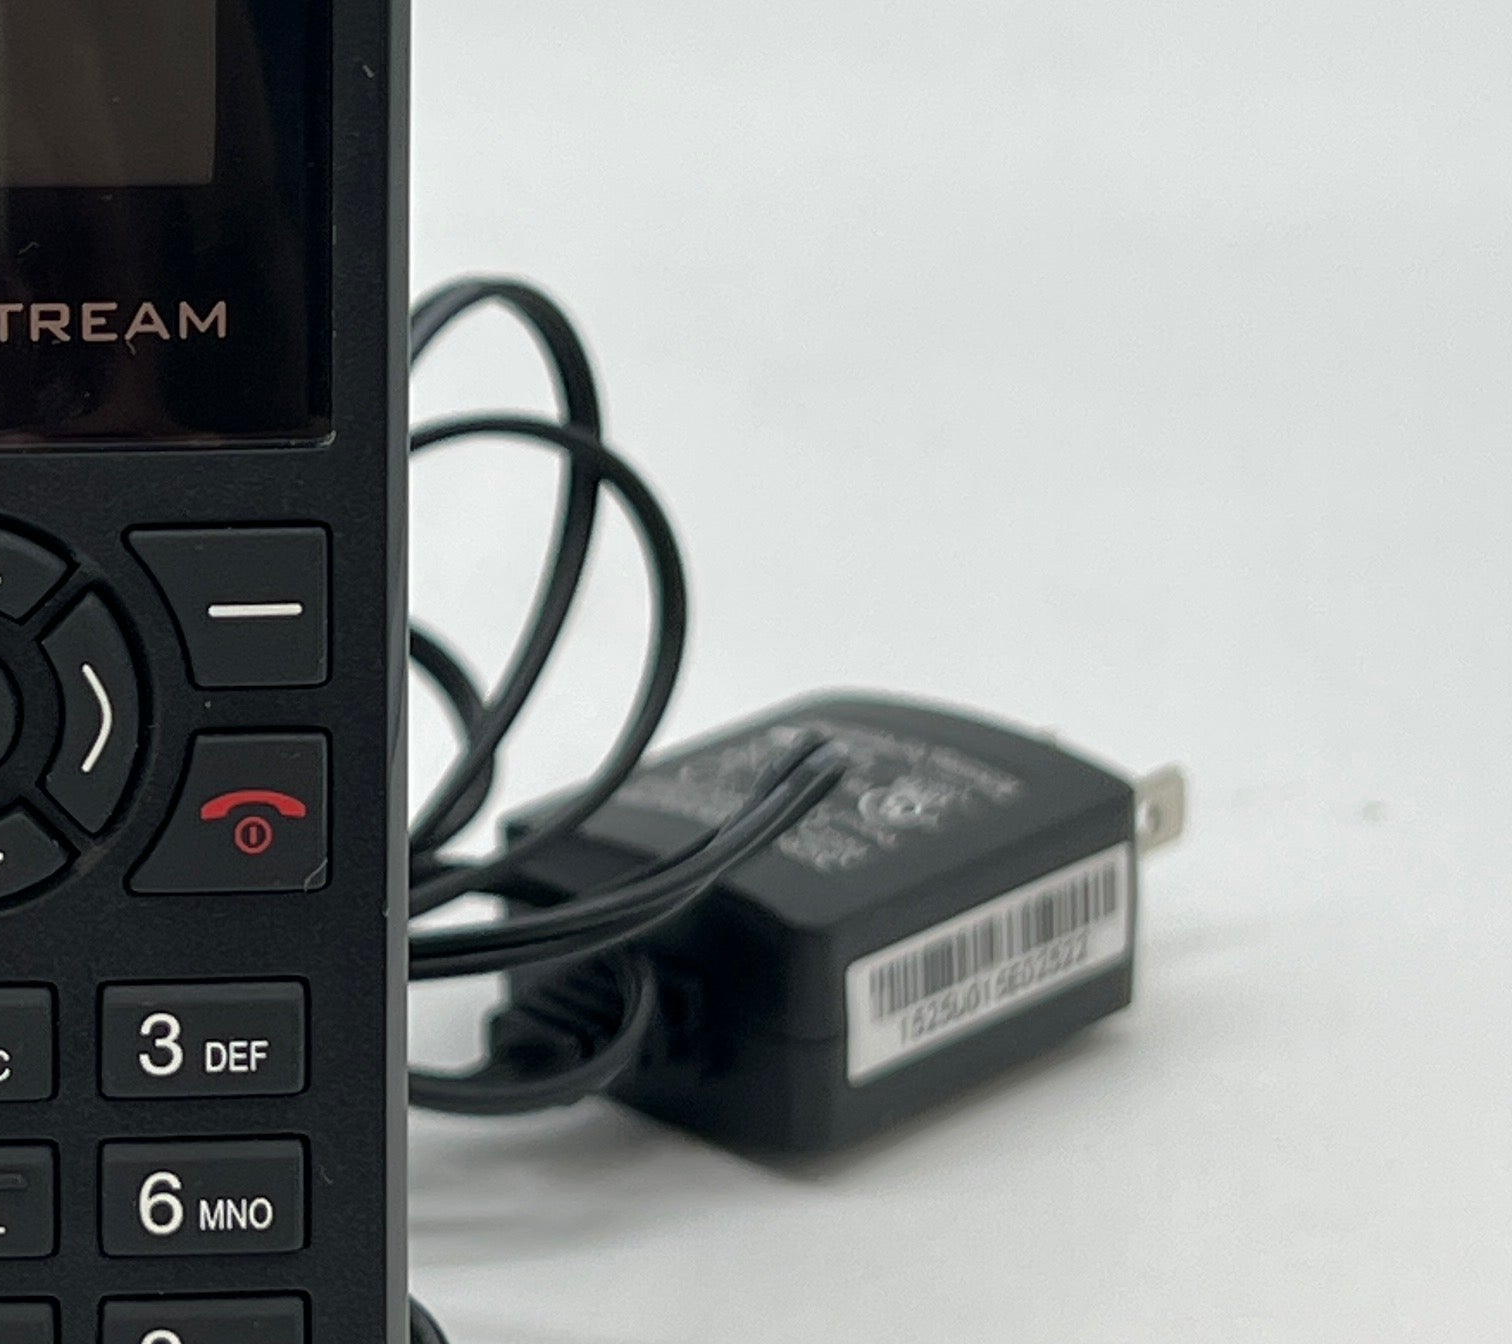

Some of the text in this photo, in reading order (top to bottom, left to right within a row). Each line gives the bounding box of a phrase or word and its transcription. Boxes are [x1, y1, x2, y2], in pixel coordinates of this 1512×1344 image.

[140, 1014, 270, 1077] 3 DEF
[140, 1172, 274, 1236] 6 MNO
